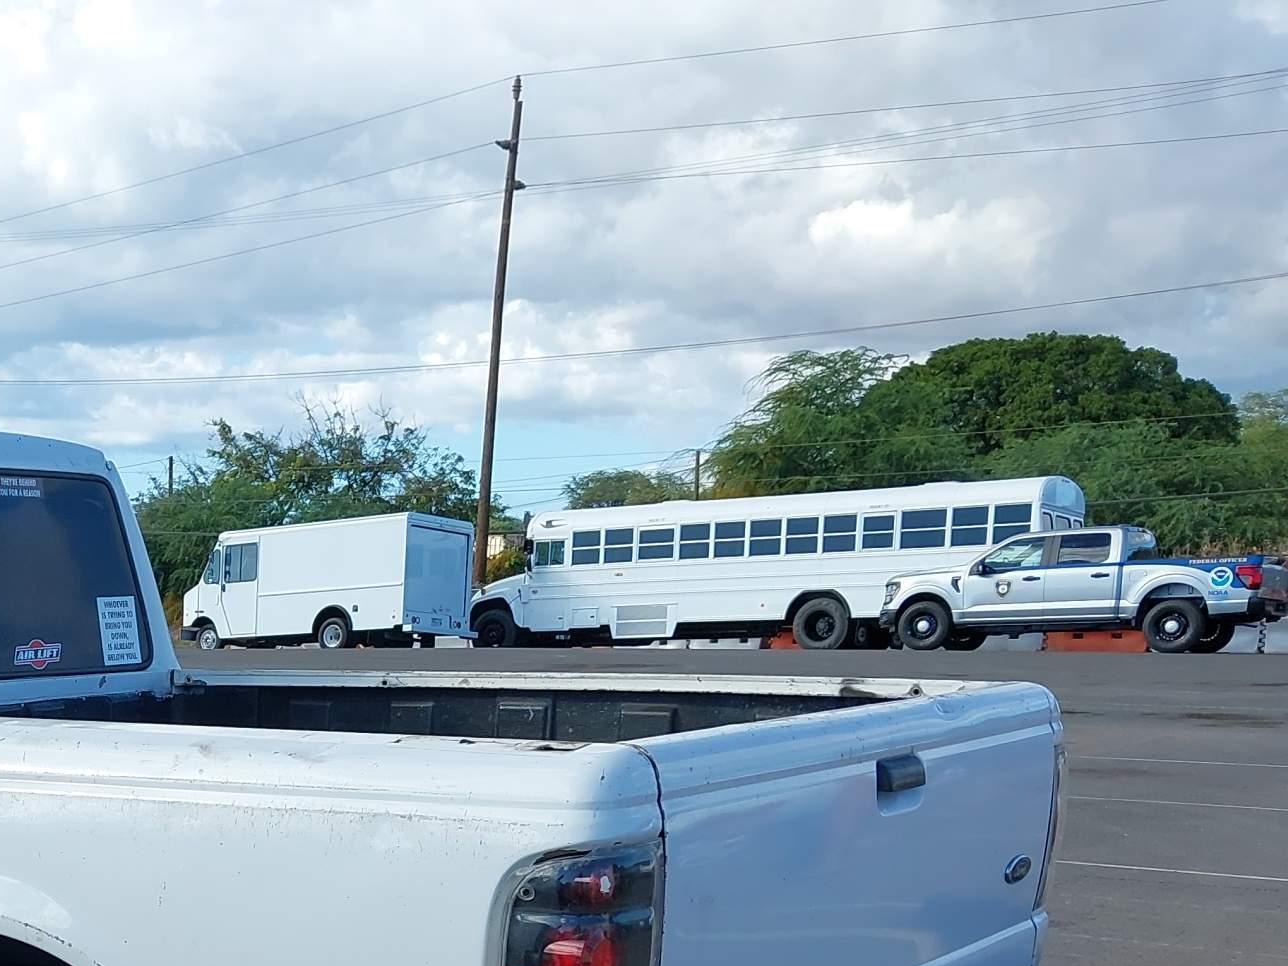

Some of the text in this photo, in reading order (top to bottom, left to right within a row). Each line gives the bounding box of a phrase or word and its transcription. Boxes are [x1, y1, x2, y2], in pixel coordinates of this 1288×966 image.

[19, 478, 36, 487] BEHIND
[9, 488, 18, 497] FOR
[19, 488, 23, 497] A
[23, 488, 40, 498] REASON
[104, 600, 128, 608] WHOEVER
[108, 611, 125, 619] TRYING
[105, 621, 133, 630] BRING YOU
[114, 642, 134, 650] ALREADY
[17, 648, 59, 661] AIR LIFT
[108, 653, 125, 661] BELOW
